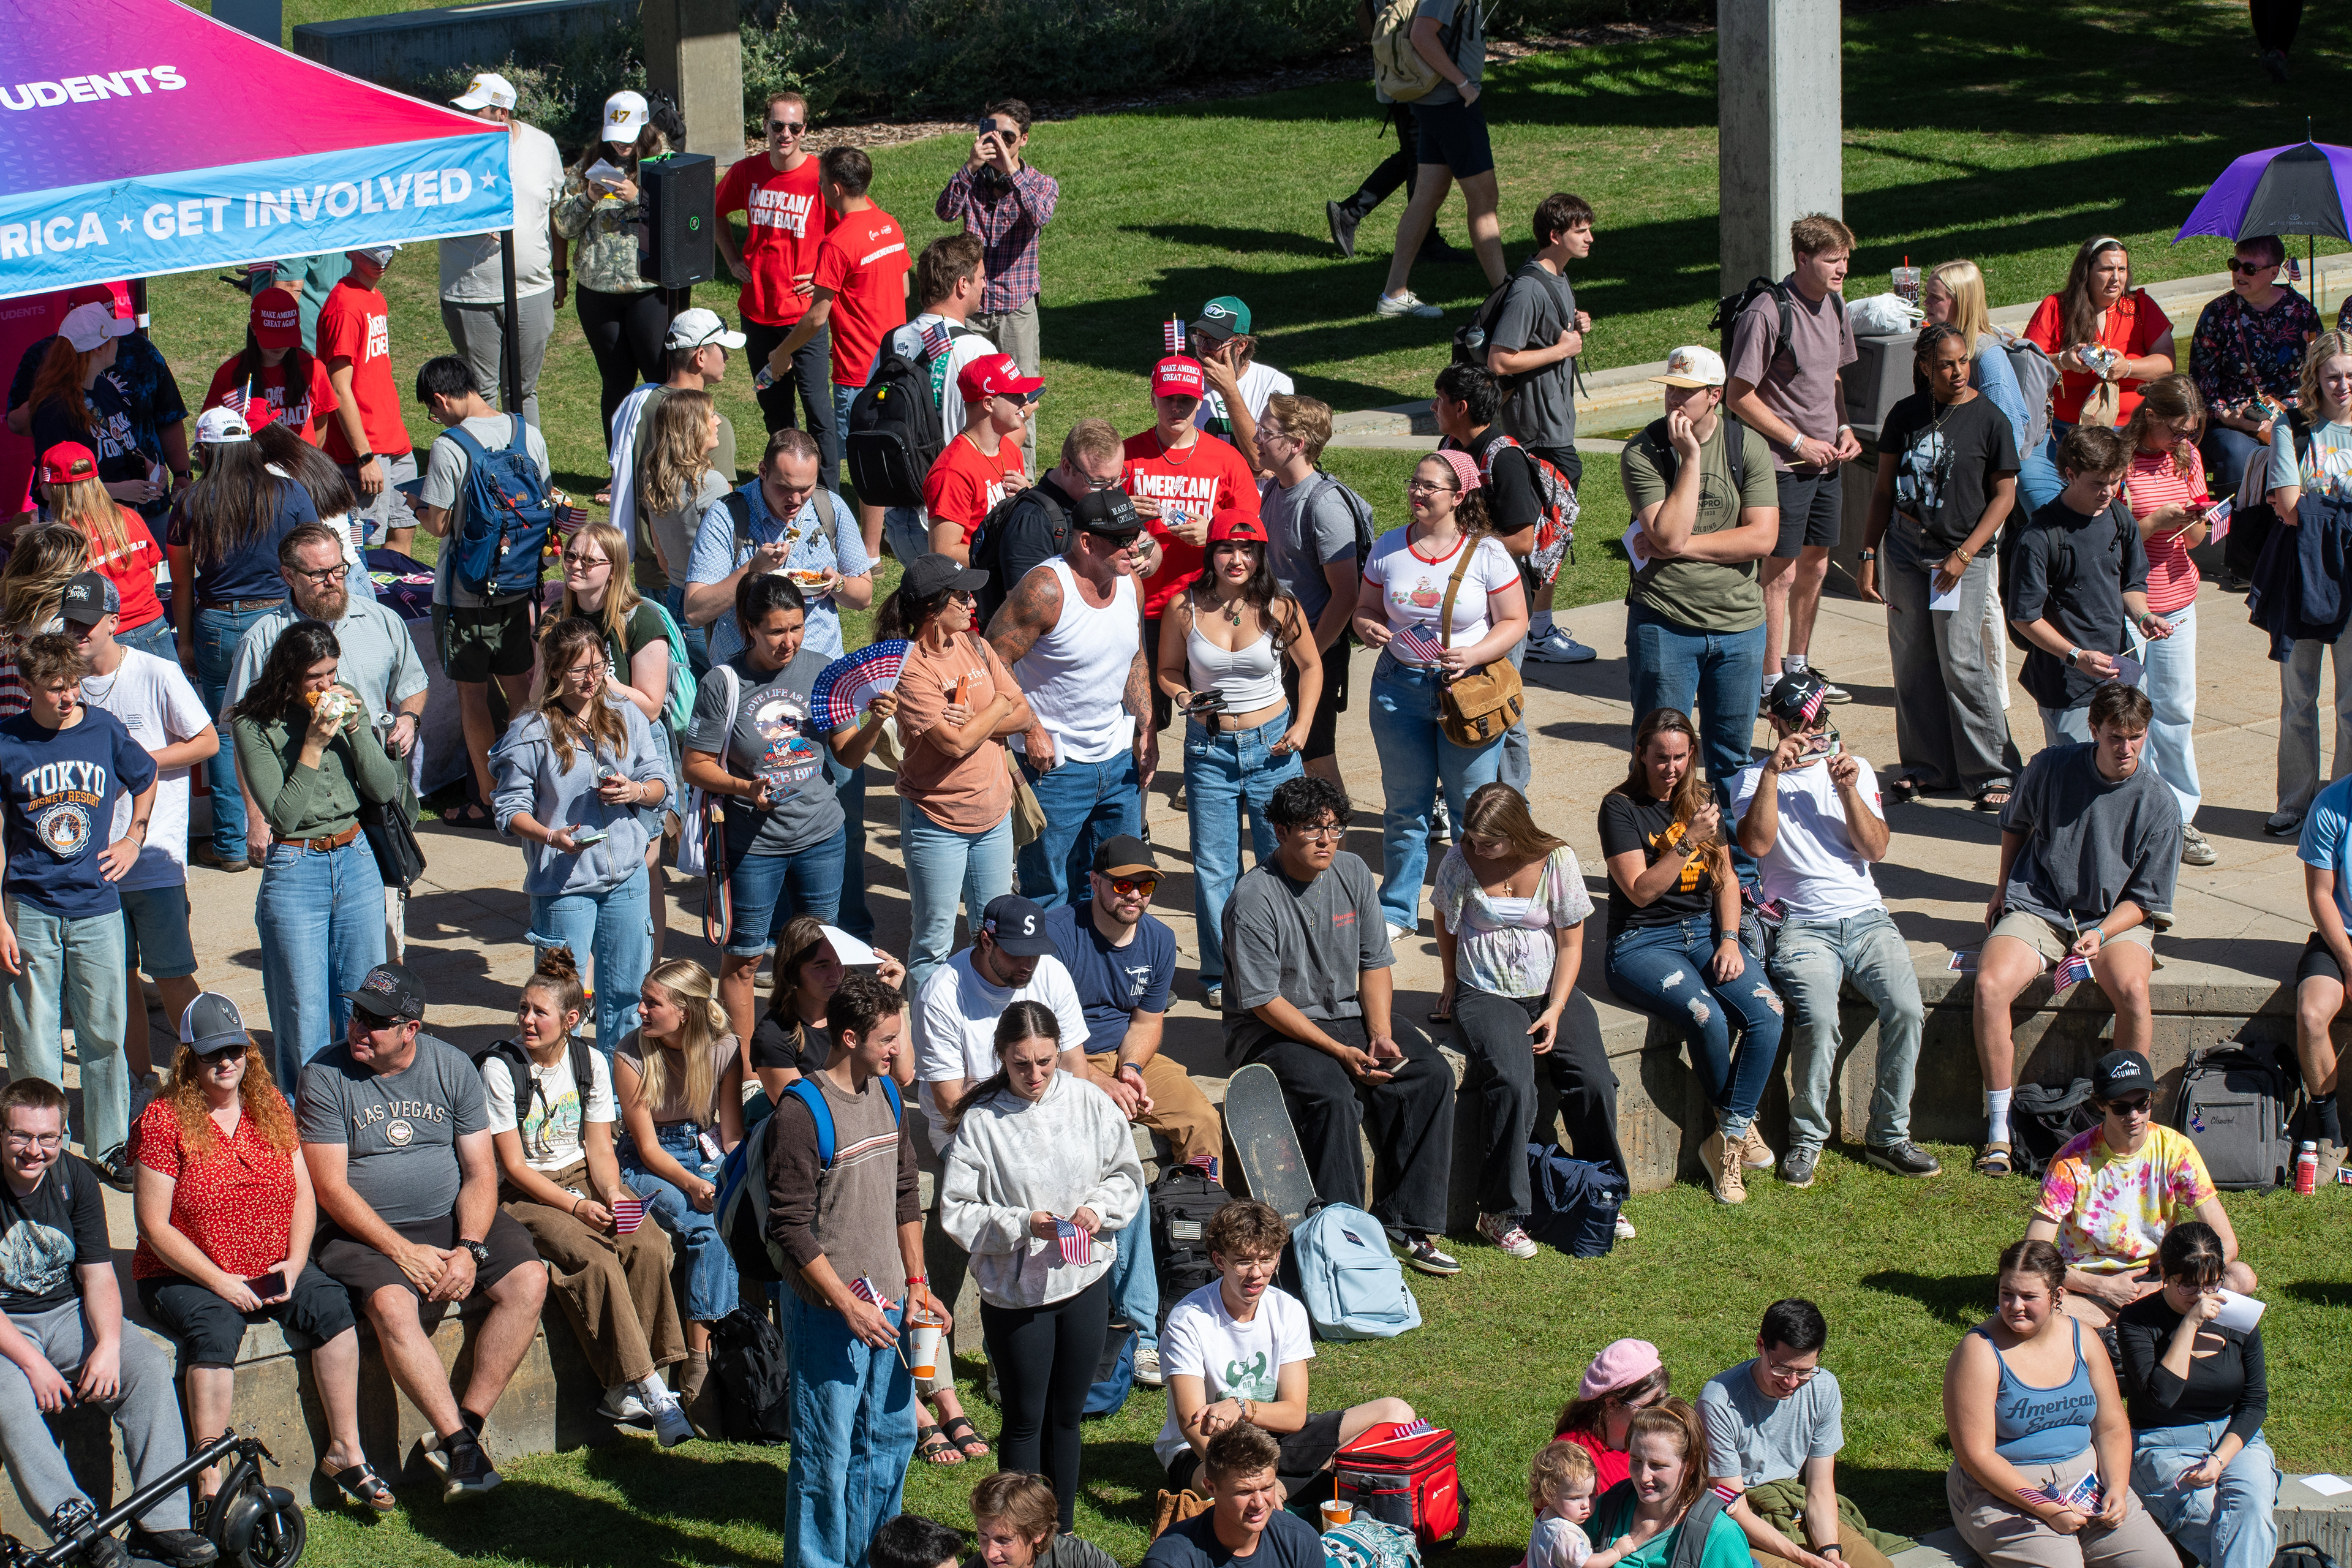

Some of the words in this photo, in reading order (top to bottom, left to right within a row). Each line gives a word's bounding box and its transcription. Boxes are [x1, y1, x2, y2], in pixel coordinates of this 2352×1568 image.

[609, 109, 630, 124] 47
[749, 189, 805, 214] AMERICAN
[0, 211, 110, 260] RICA
[143, 196, 232, 241] GET
[244, 167, 472, 229] INVOLVED
[750, 207, 807, 233] COMEBACK
[261, 310, 276, 318] MAKE
[276, 309, 297, 318] AMERICA
[263, 319, 281, 328] GREAT
[281, 318, 295, 328] AGAIN
[1000, 360, 1013, 374] MAKE
[1160, 364, 1177, 373] MAKE
[1178, 364, 1200, 376] AMERICA
[1182, 374, 1198, 385] AGAIN
[1134, 475, 1210, 499] AMERICAN
[1111, 504, 1128, 516] MAKE
[1697, 499, 1721, 508] NPRO
[1117, 513, 1134, 524] GREAT
[1692, 522, 1717, 533] UILDING
[744, 693, 766, 717] LOVE
[766, 688, 788, 699] LIFE
[789, 691, 803, 703] AS
[802, 700, 810, 709] A
[22, 761, 107, 800] TOKYO
[28, 792, 65, 812] DISNEY
[67, 791, 100, 809] RESORT
[48, 807, 73, 820] DREAMS
[73, 809, 86, 823] COME
[1023, 914, 1036, 936] S
[391, 976, 401, 984] LAS
[1130, 982, 1145, 997] LINE
[2117, 1069, 2140, 1078] SUMMIT
[353, 1104, 385, 1131] LAS
[388, 1101, 445, 1123] VEGAS
[2210, 1116, 2235, 1125] Cloward
[2005, 1394, 2096, 1420] American
[2024, 1409, 2084, 1434] Eagle
